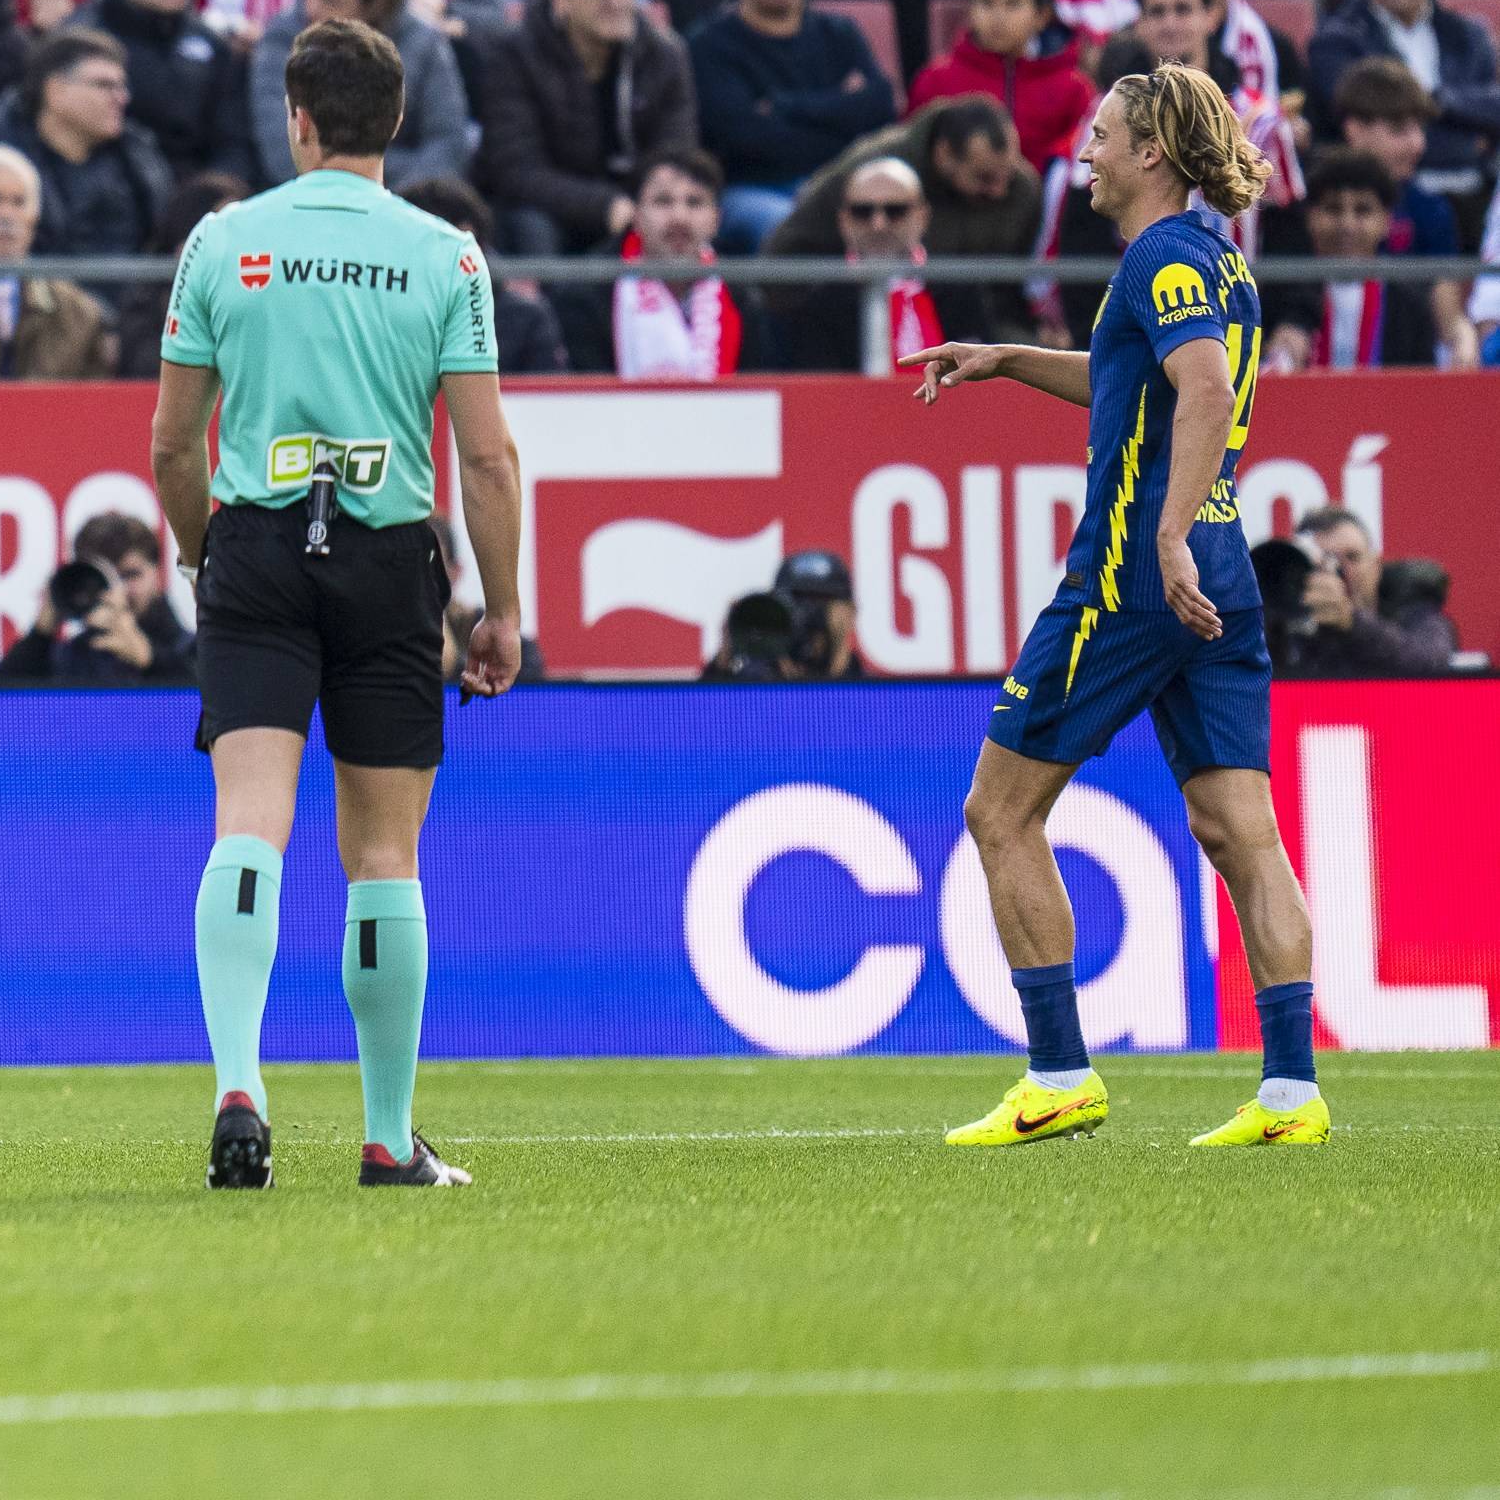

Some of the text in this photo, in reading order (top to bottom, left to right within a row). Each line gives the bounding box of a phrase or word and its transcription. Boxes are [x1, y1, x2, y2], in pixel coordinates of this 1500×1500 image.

[282, 258, 410, 294] WÜRTH
[1157, 304, 1213, 327] kraken
[273, 441, 387, 484] BKT
